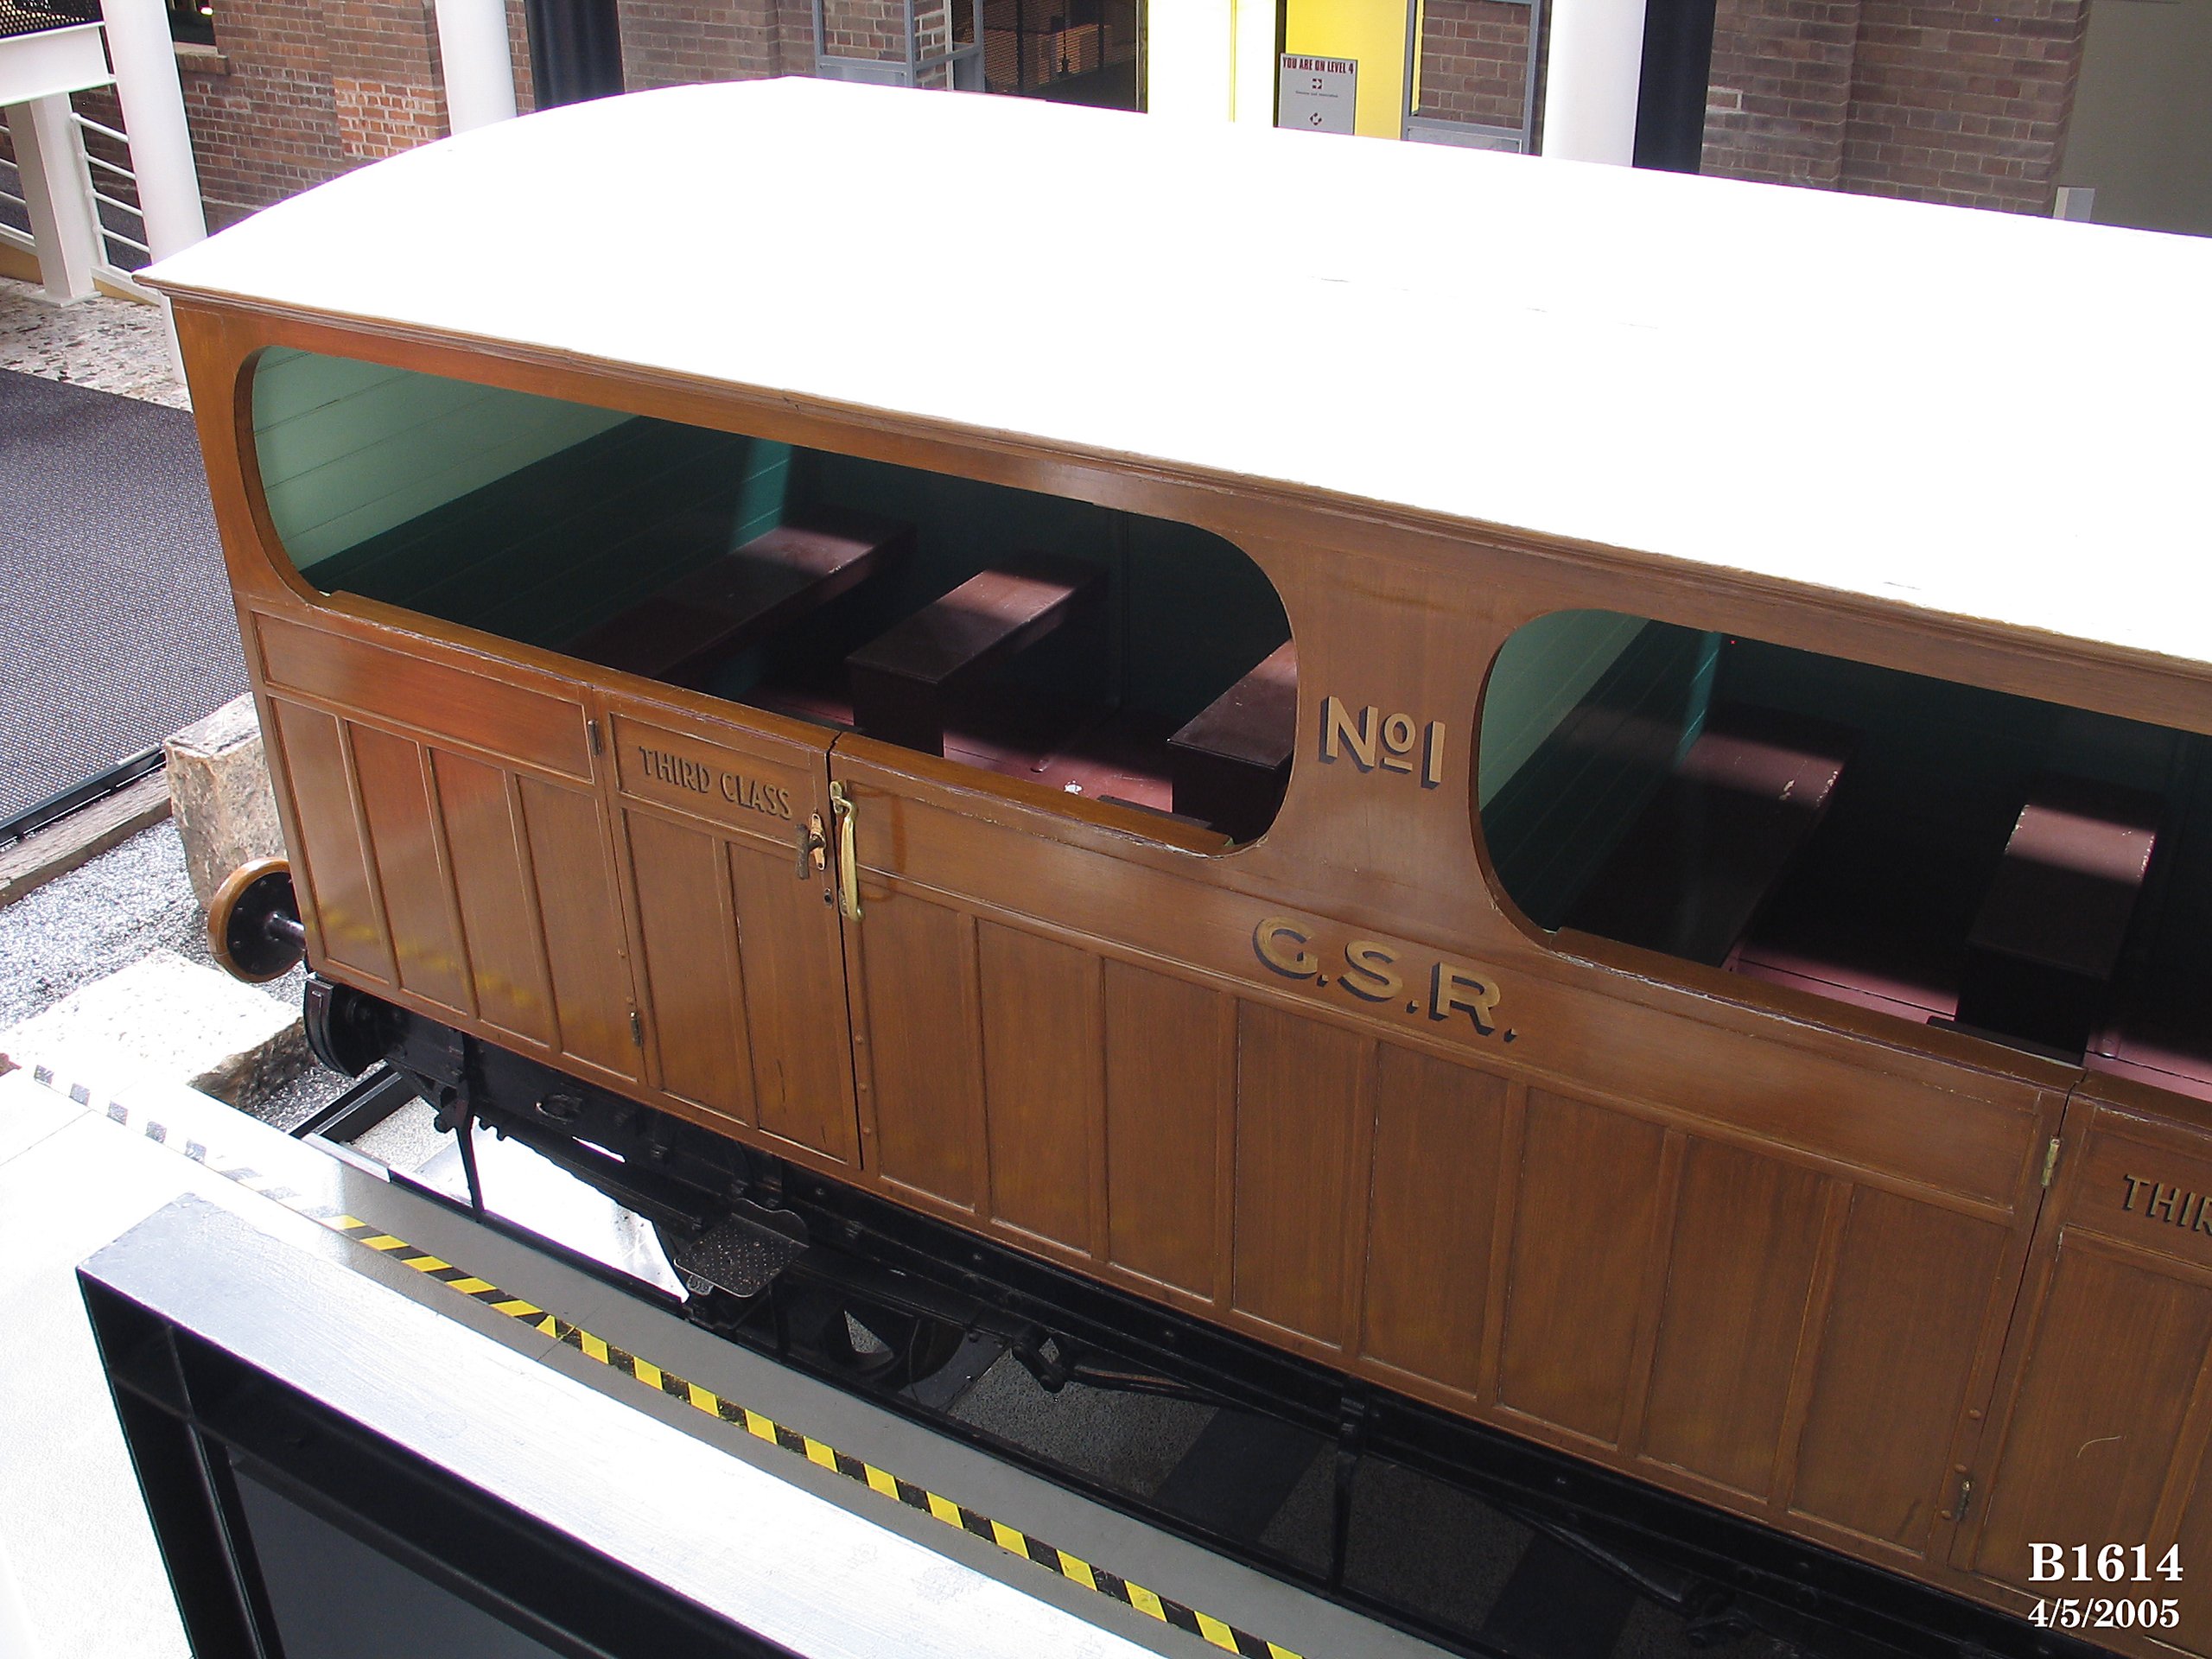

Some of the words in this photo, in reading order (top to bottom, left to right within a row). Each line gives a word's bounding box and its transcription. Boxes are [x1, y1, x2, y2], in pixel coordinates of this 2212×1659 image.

[1283, 57, 1297, 68] YOU
[1299, 58, 1313, 70] ARE
[1315, 60, 1325, 72] ON
[1327, 61, 1345, 73] LEVEL
[1348, 63, 1354, 74] 4
[639, 746, 711, 793] THIRD
[720, 772, 792, 820] CLASS
[1252, 915, 1518, 1043] G.S.R.
